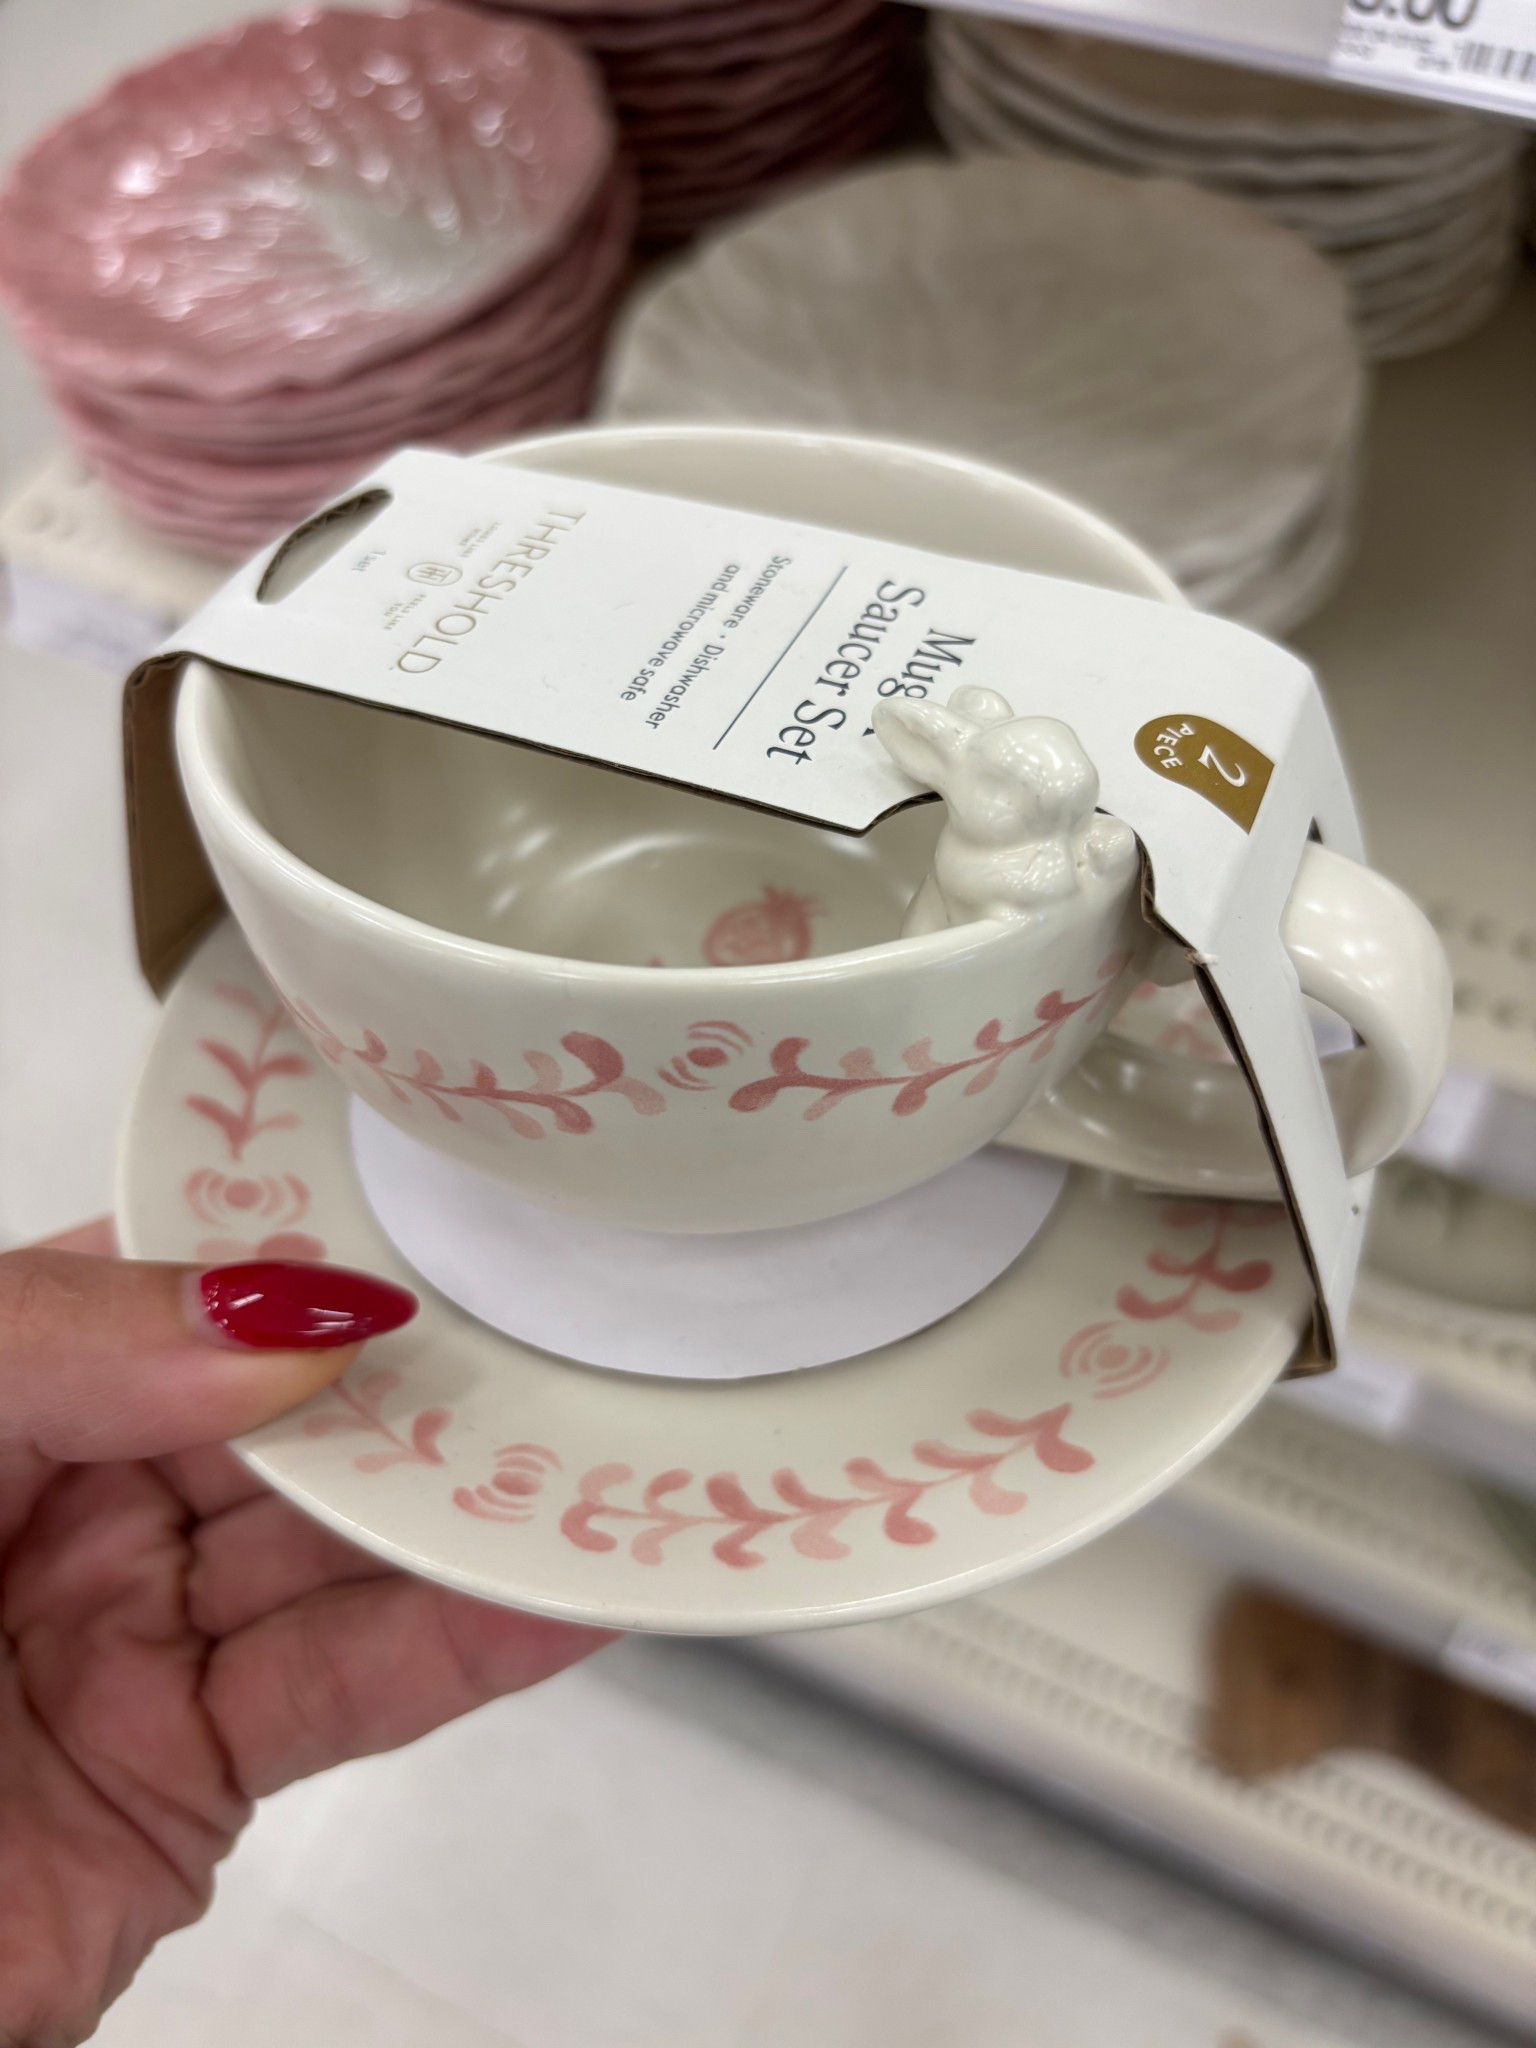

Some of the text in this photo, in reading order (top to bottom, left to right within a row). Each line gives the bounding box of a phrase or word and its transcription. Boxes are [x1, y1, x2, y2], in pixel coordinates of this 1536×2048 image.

[384, 602, 403, 618] YOU
[397, 511, 586, 673] THRESHOLD
[620, 563, 740, 701] and microwave safe
[645, 555, 793, 729] Stoneware Dishwasher
[766, 580, 926, 765] Saucer Set
[877, 627, 977, 699] Mug
[1153, 722, 1195, 769] PIECE
[1197, 745, 1245, 788] 2
